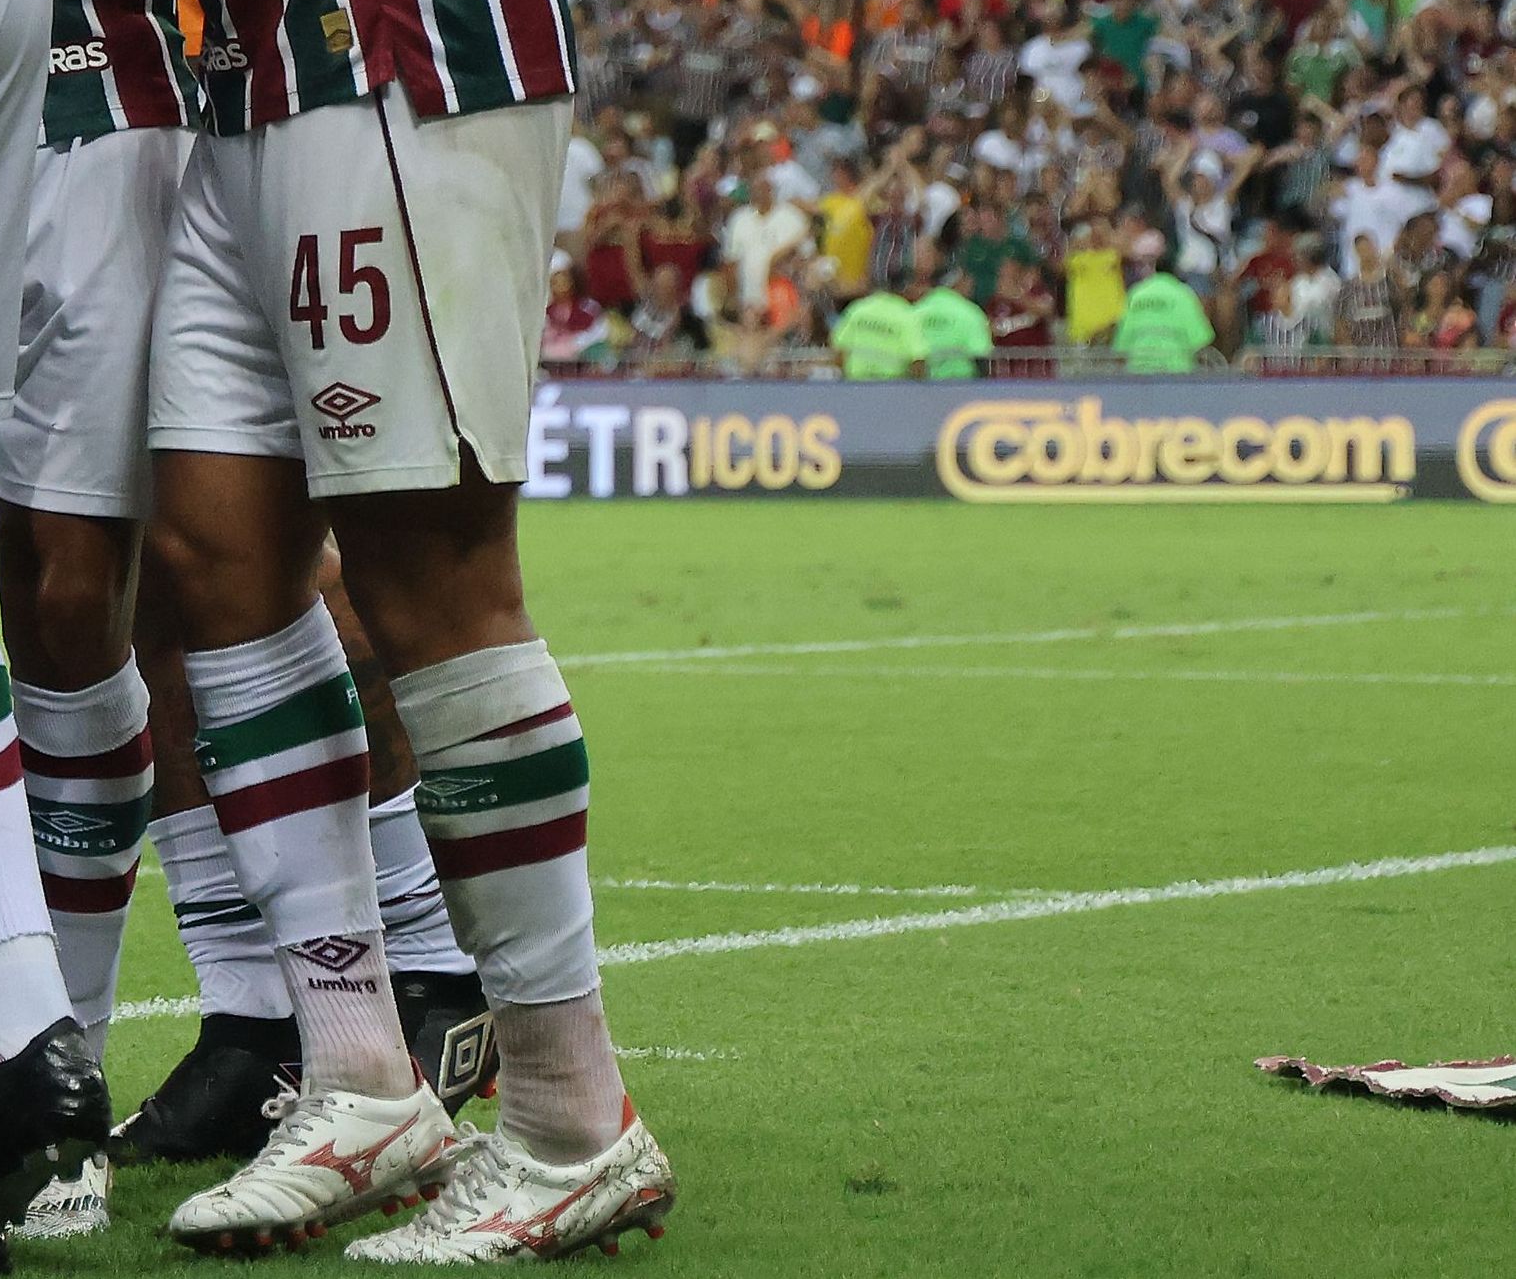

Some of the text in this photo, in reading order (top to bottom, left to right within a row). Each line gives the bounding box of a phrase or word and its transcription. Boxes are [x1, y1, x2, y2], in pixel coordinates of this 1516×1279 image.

[290, 227, 391, 350] 45
[521, 383, 842, 498] ÉTRICOS
[308, 975, 377, 994] umbro
